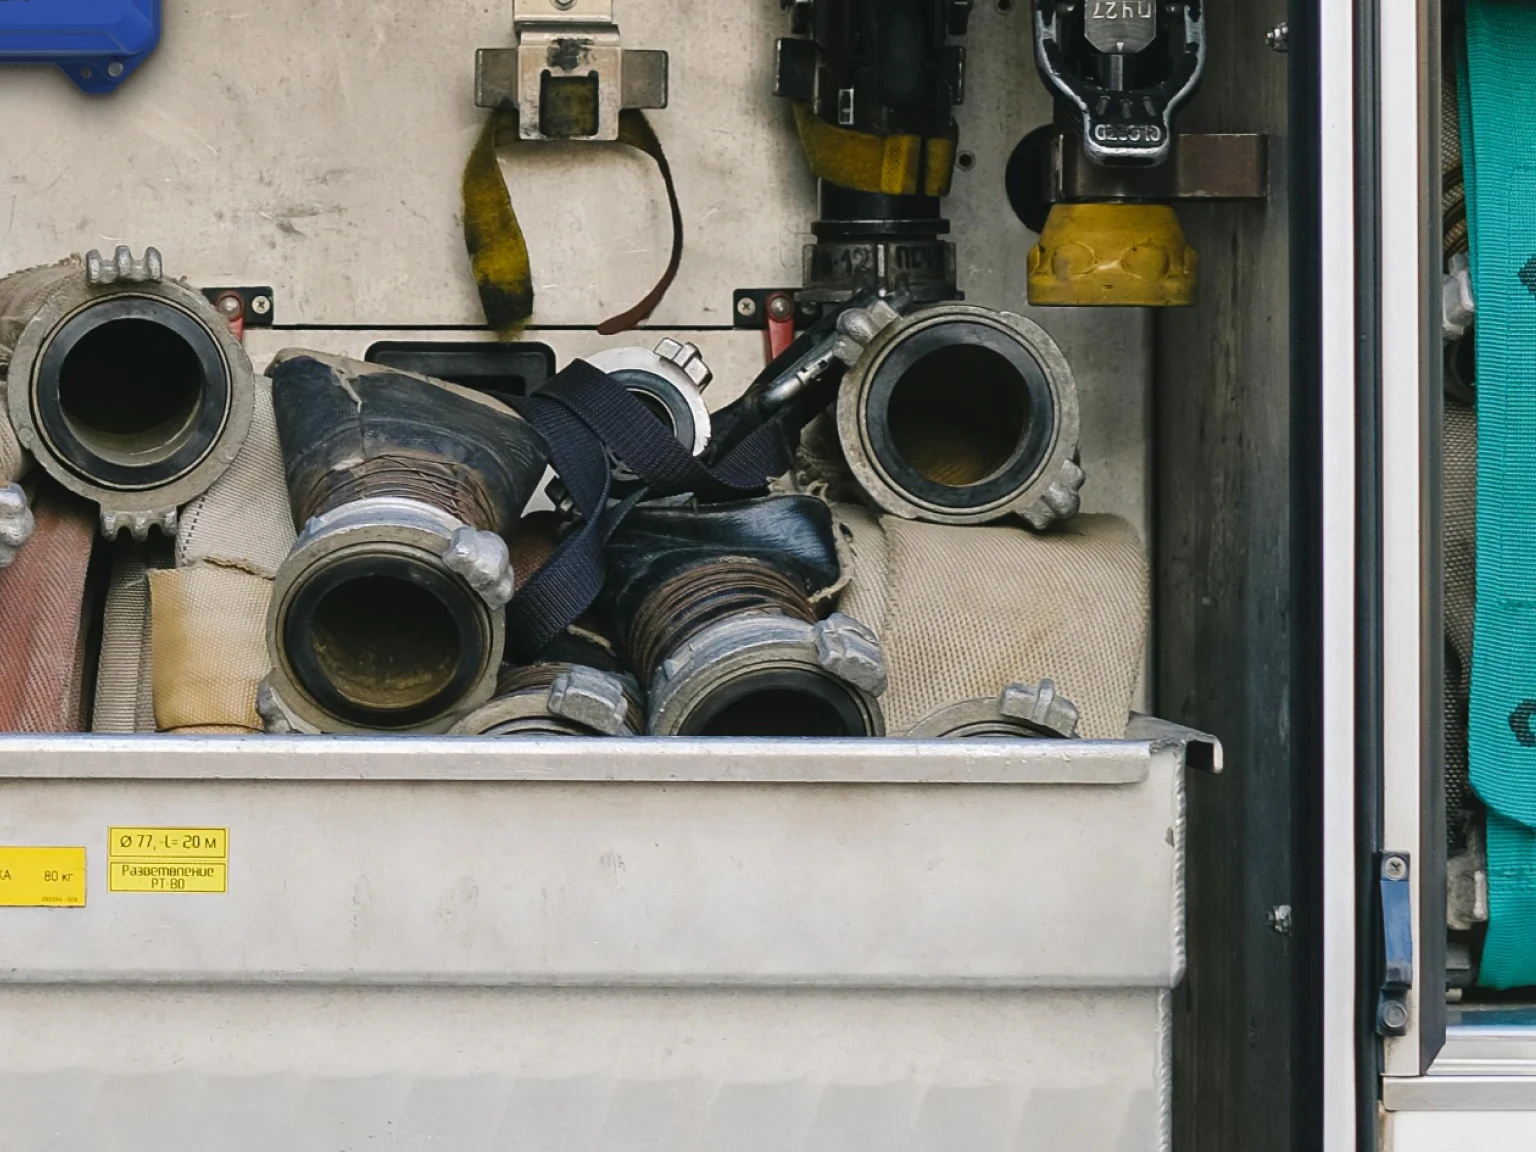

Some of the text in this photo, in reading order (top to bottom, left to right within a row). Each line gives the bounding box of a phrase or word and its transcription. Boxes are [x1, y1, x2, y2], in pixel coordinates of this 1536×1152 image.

[183, 834, 200, 849] 20
[43, 870, 59, 882] 80
[61, 873, 74, 882] кг
[121, 864, 215, 877] Разветвление
